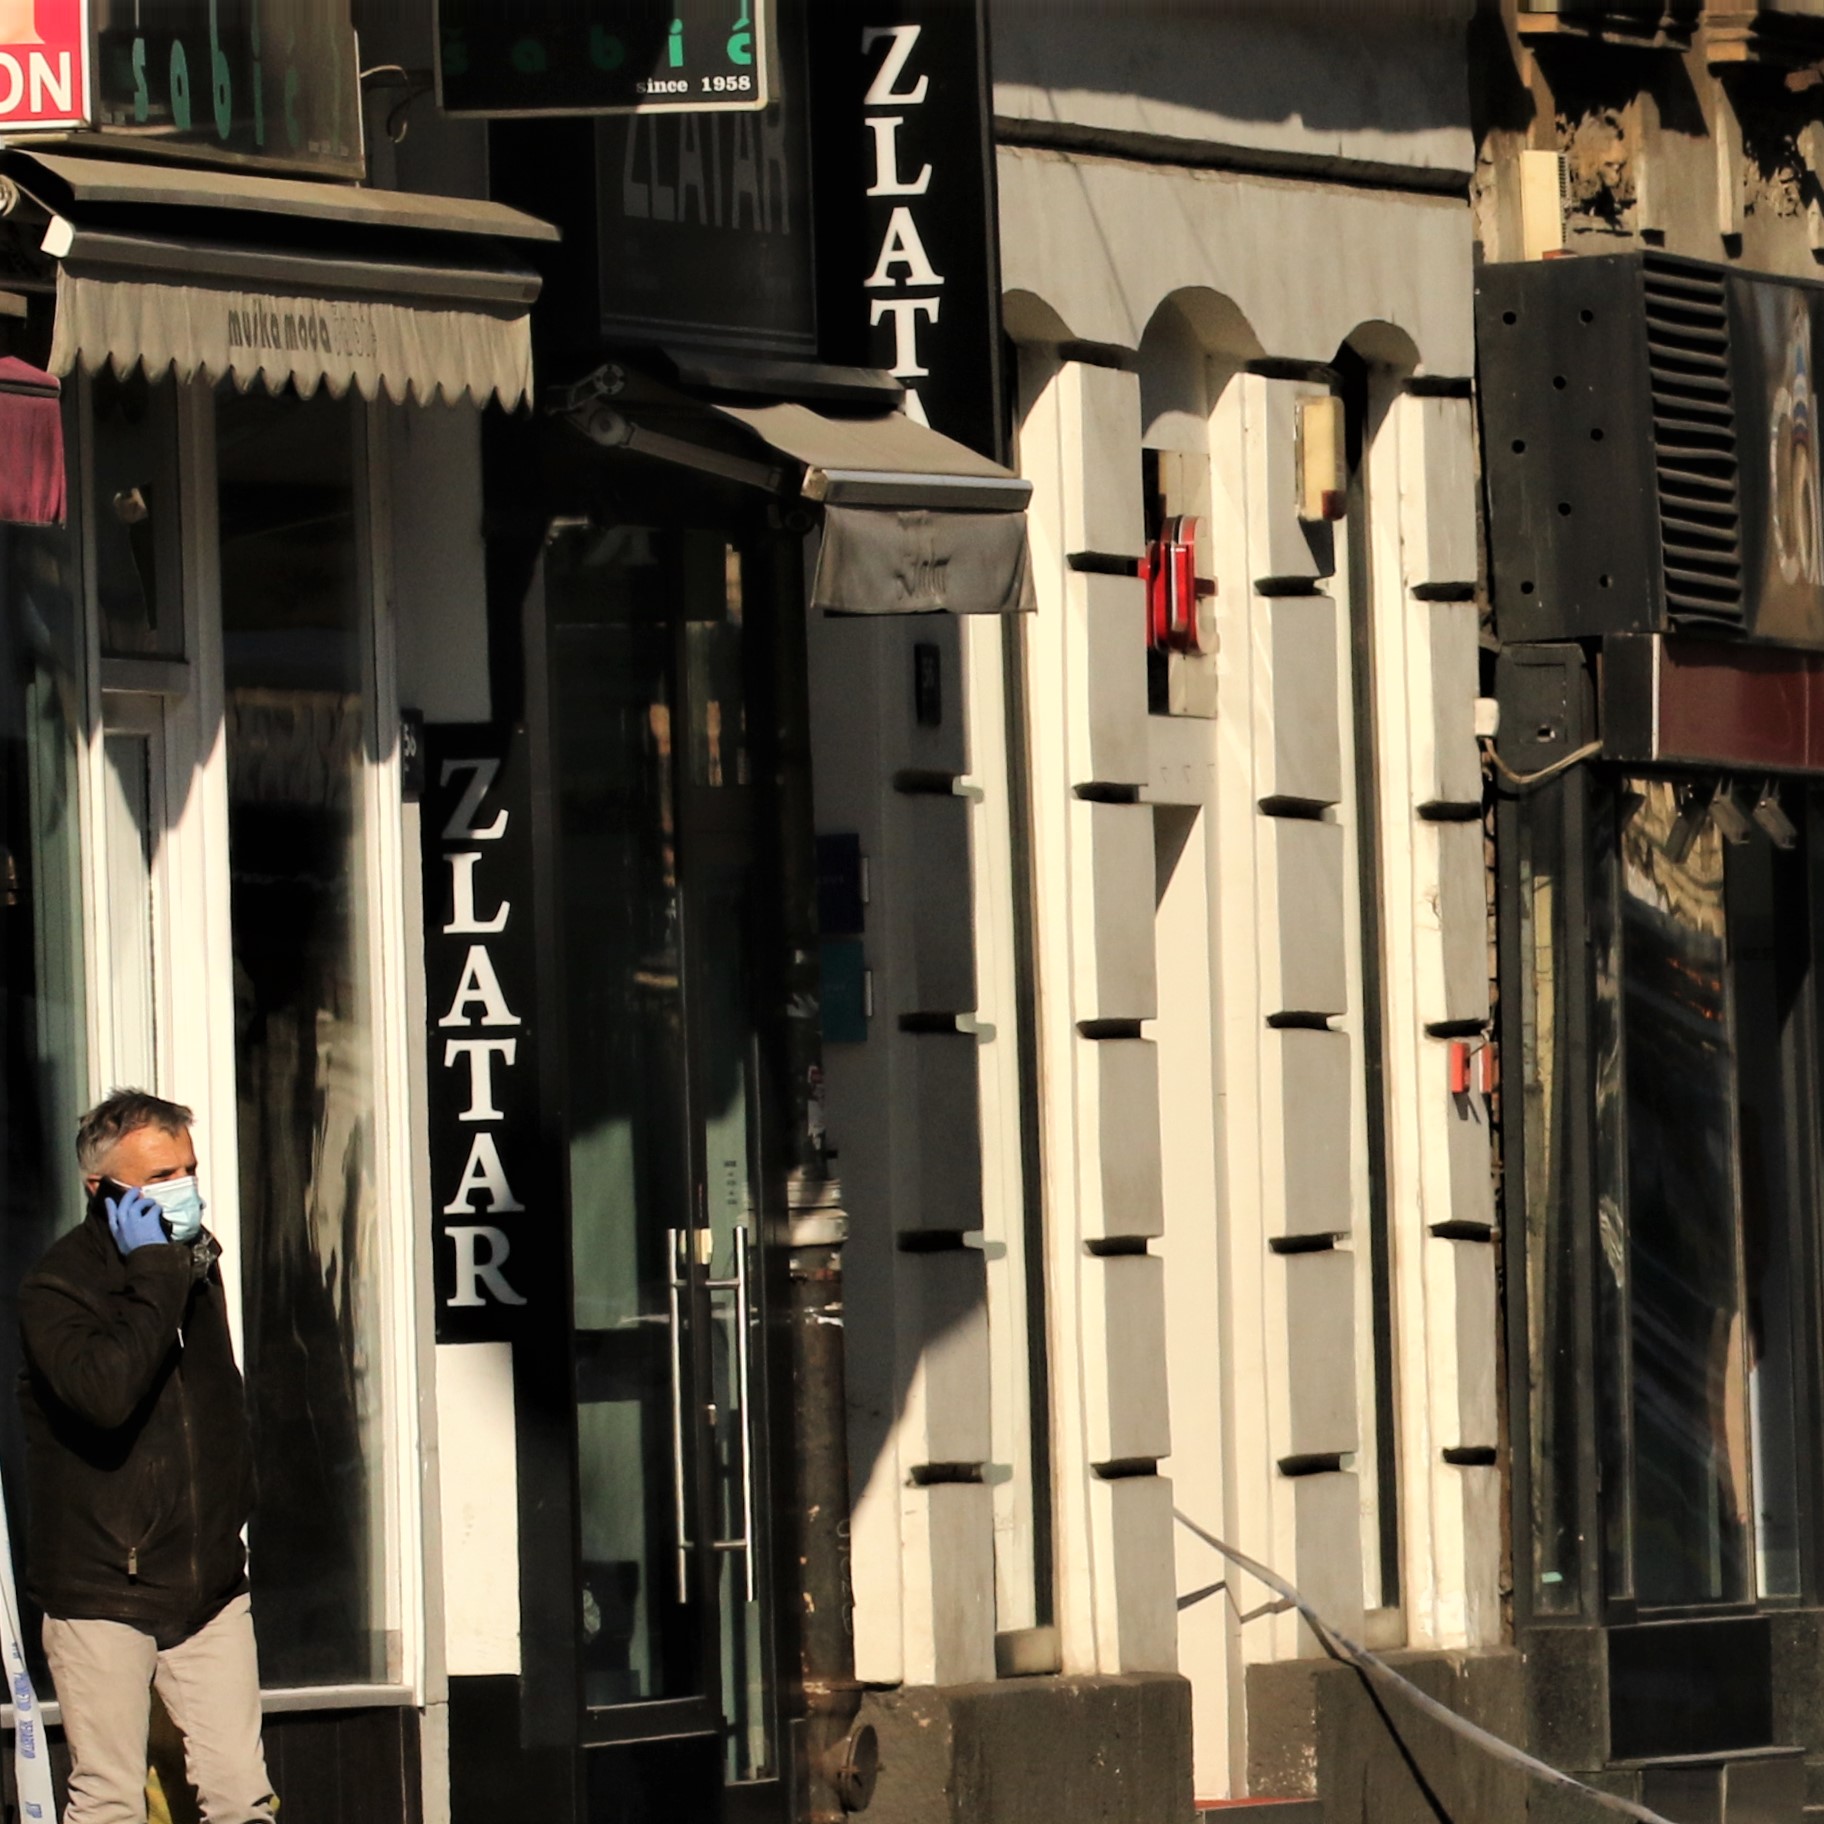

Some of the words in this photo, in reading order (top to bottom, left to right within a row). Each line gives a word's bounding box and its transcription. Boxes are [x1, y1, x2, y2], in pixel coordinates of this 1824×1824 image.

[636, 77, 688, 94] since
[701, 76, 751, 92] 1958
[438, 758, 527, 1308] ZLATAR
